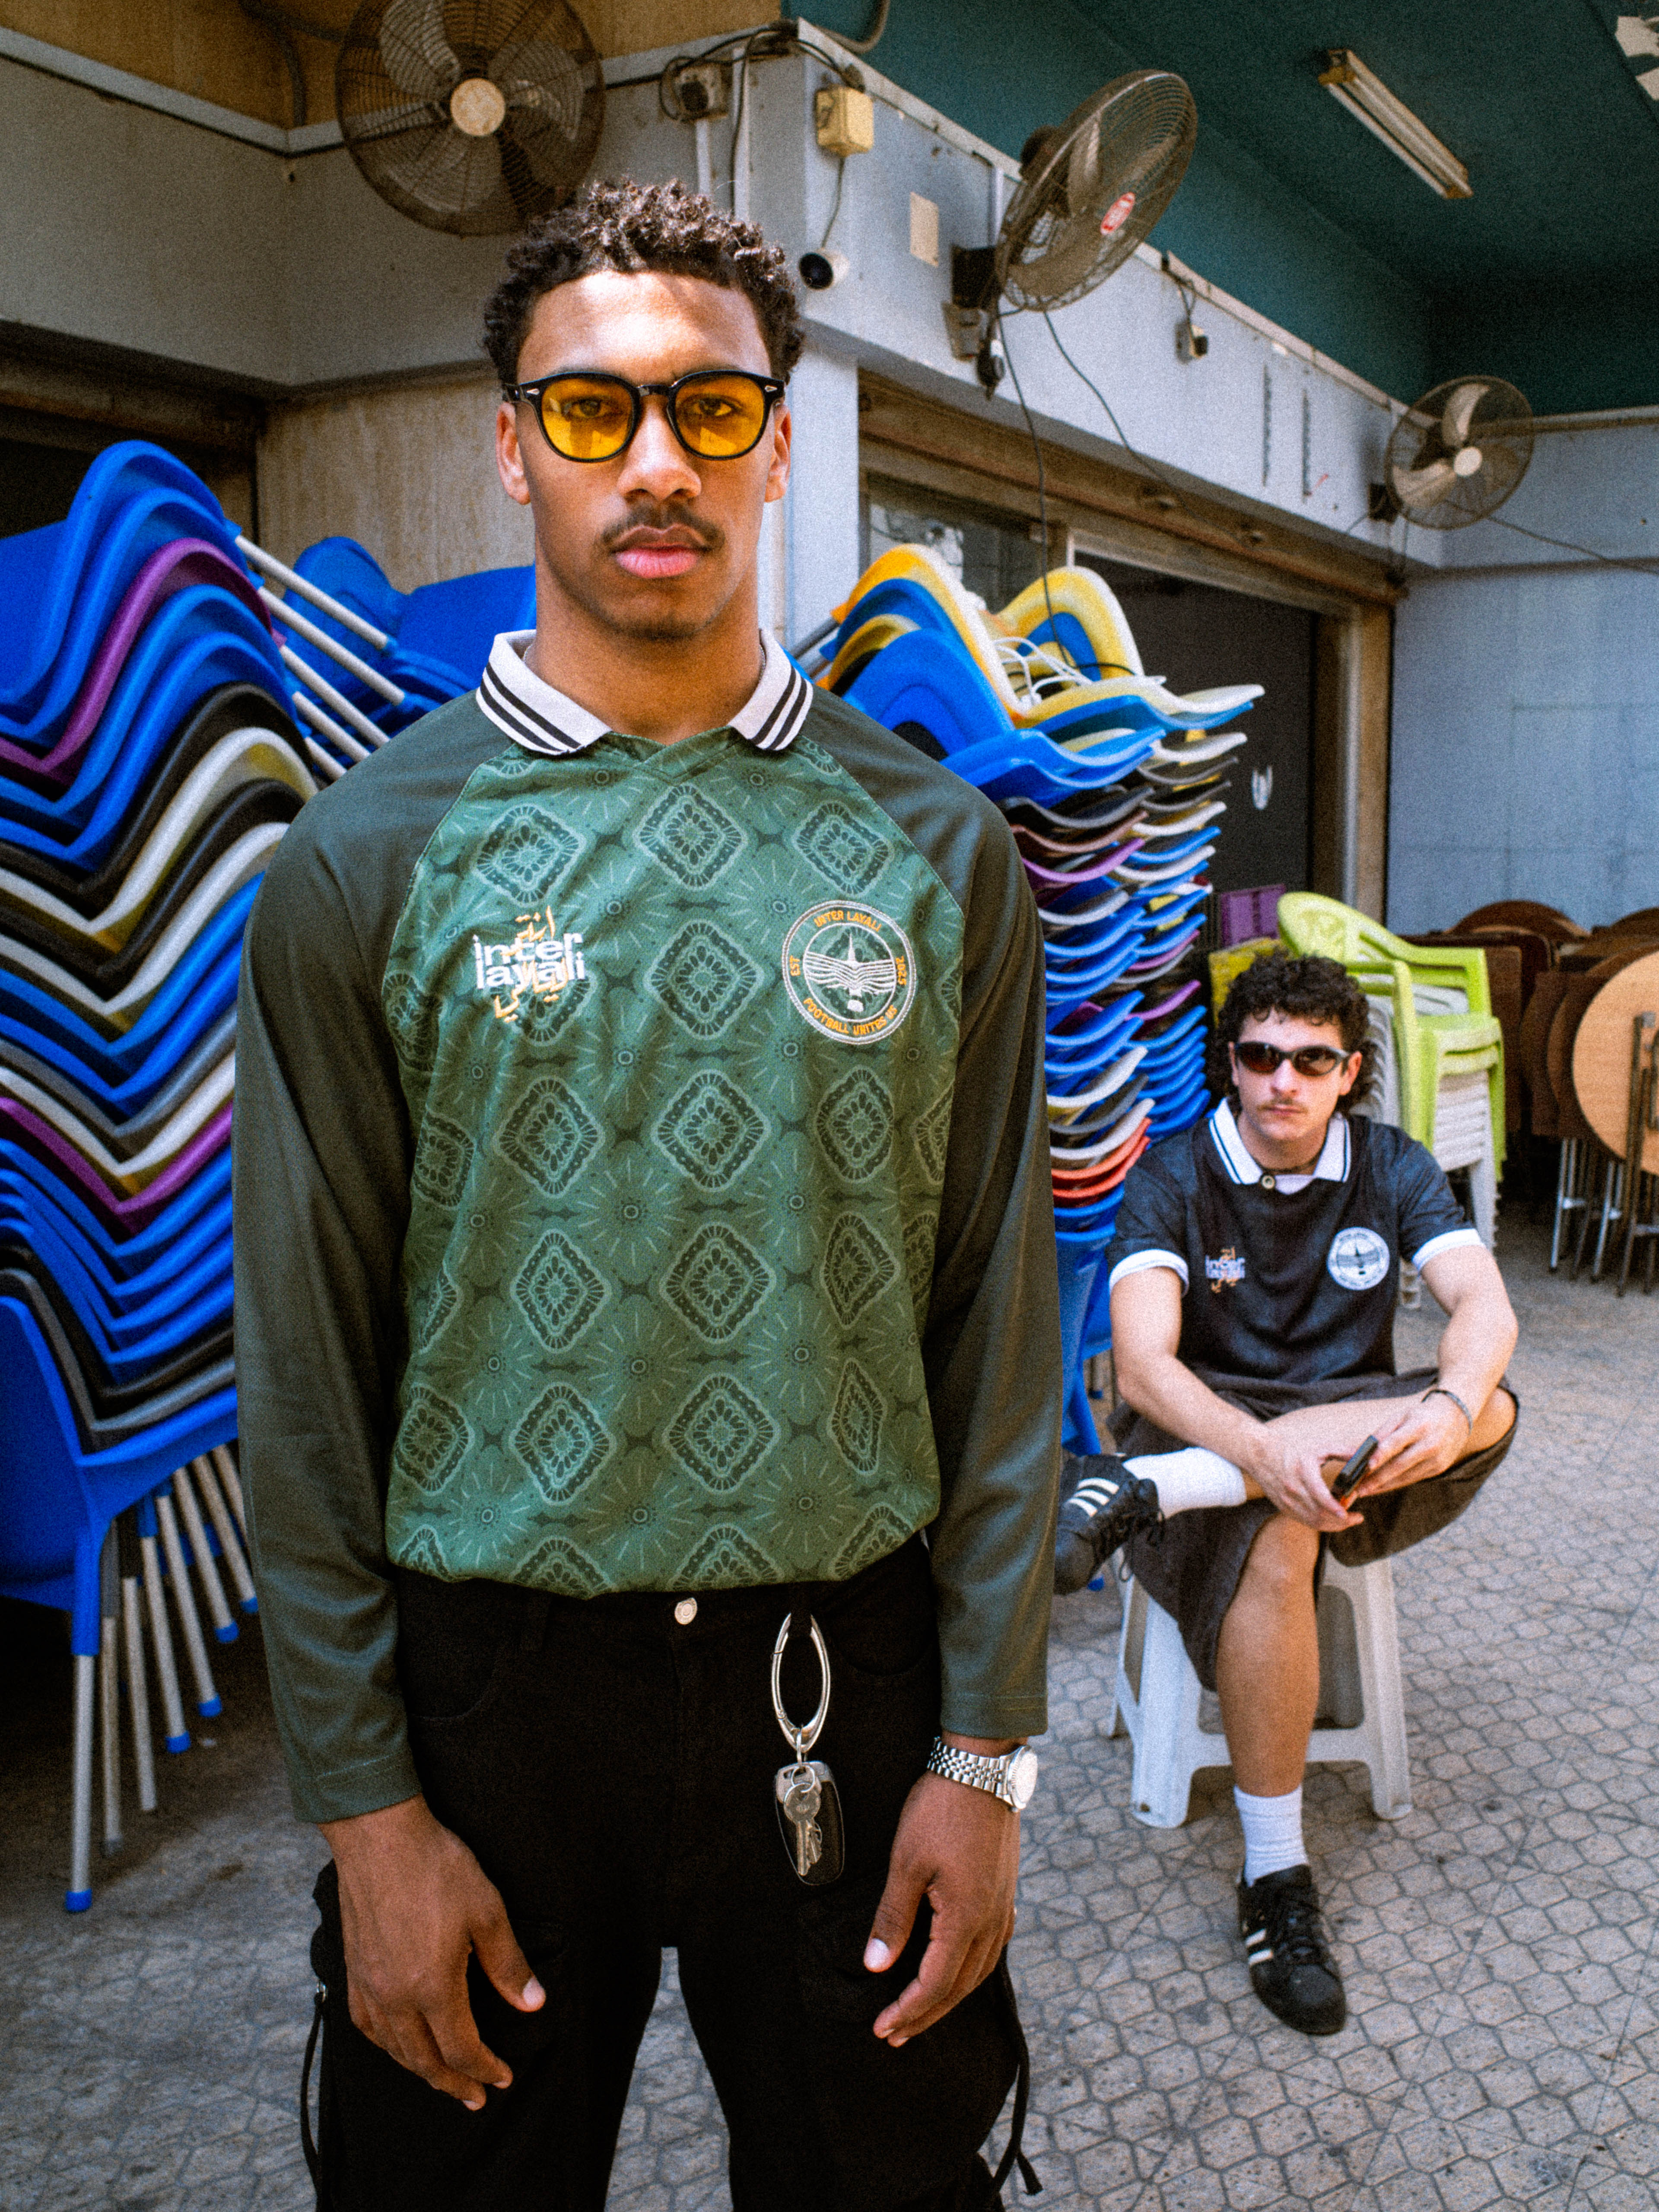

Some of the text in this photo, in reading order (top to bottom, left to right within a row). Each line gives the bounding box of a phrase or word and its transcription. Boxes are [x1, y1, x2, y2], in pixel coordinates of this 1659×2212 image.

[814, 910, 882, 932] INTER LAYALI
[789, 955, 801, 976] EST
[896, 955, 907, 985] 2025
[803, 998, 898, 1036] FOOTBALL UNITES US
